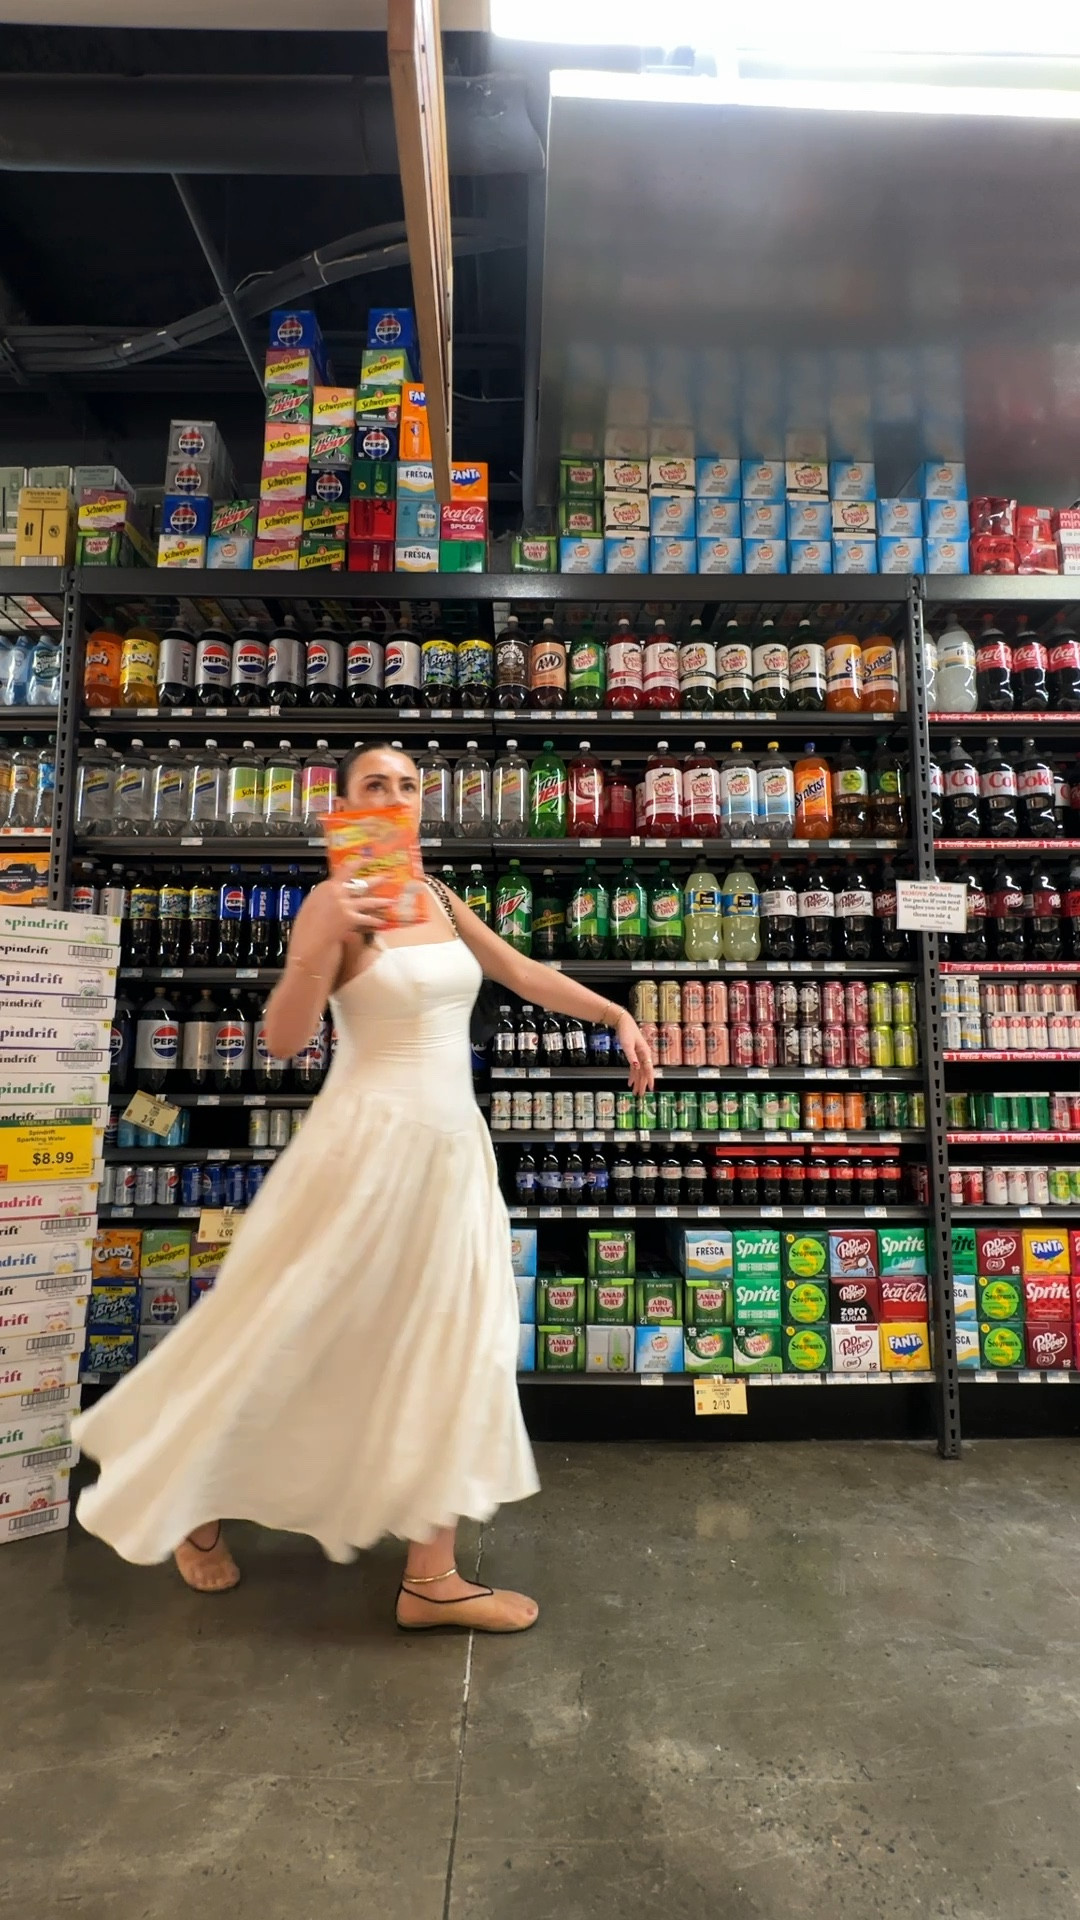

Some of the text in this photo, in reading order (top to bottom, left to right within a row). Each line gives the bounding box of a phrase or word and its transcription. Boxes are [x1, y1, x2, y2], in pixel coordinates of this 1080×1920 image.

[269, 360, 304, 376] Schweppes
[367, 360, 401, 376] Schweppes
[318, 400, 353, 414] Schweppes
[362, 396, 397, 409] Schweppes
[269, 437, 305, 451] Schweppes
[405, 470, 433, 480] FRESCA
[452, 468, 481, 480] FANTA
[267, 475, 302, 490] Schweppes
[86, 502, 122, 516] Schweppes
[264, 514, 300, 529] Schweppes
[310, 514, 344, 528] Schweppes
[163, 546, 200, 561] Schweppes
[257, 553, 293, 568] Schweppes
[304, 553, 340, 567] Schweppes
[403, 551, 431, 560] FRESCA
[202, 655, 230, 667] PEPSI
[238, 655, 265, 665] PEPSI
[536, 655, 560, 672] A&W
[863, 650, 893, 676] Sunkist
[182, 658, 190, 681] DIET
[5, 916, 69, 931] spindrift
[0, 943, 49, 955] spindrift
[0, 971, 63, 986] spindrift
[216, 1039, 245, 1047] PEPSI
[32, 1151, 74, 1166] $8.99
[624, 1233, 632, 1241] 12
[94, 1244, 133, 1262] Crush
[695, 1247, 725, 1256] FRESCA
[736, 1239, 780, 1258] Sprite
[837, 1240, 869, 1259] Pepper
[881, 1236, 925, 1256] Sprite
[983, 1240, 1013, 1258] Pepper
[1031, 1240, 1063, 1254] FANTA
[147, 1248, 186, 1266] Schweppes
[604, 1251, 620, 1259] DRY
[866, 1268, 874, 1276] 12
[736, 1285, 780, 1306] Sprite
[839, 1286, 866, 1302] Pepper
[1026, 1283, 1070, 1303] Sprite
[96, 1297, 127, 1319] Brisk
[152, 1304, 178, 1312] PEPSI
[554, 1298, 570, 1306] DRY
[604, 1298, 620, 1306] DRY
[840, 1307, 867, 1317] zero
[574, 1327, 581, 1335] 12
[688, 1327, 697, 1335] 12
[737, 1327, 745, 1335] 12
[840, 1338, 870, 1356] Pepper
[888, 1334, 923, 1348] FANTA
[1033, 1336, 1065, 1354] Pepper
[704, 1345, 717, 1353] DRY
[752, 1345, 766, 1353] DRY
[94, 1347, 124, 1367] Brisk
